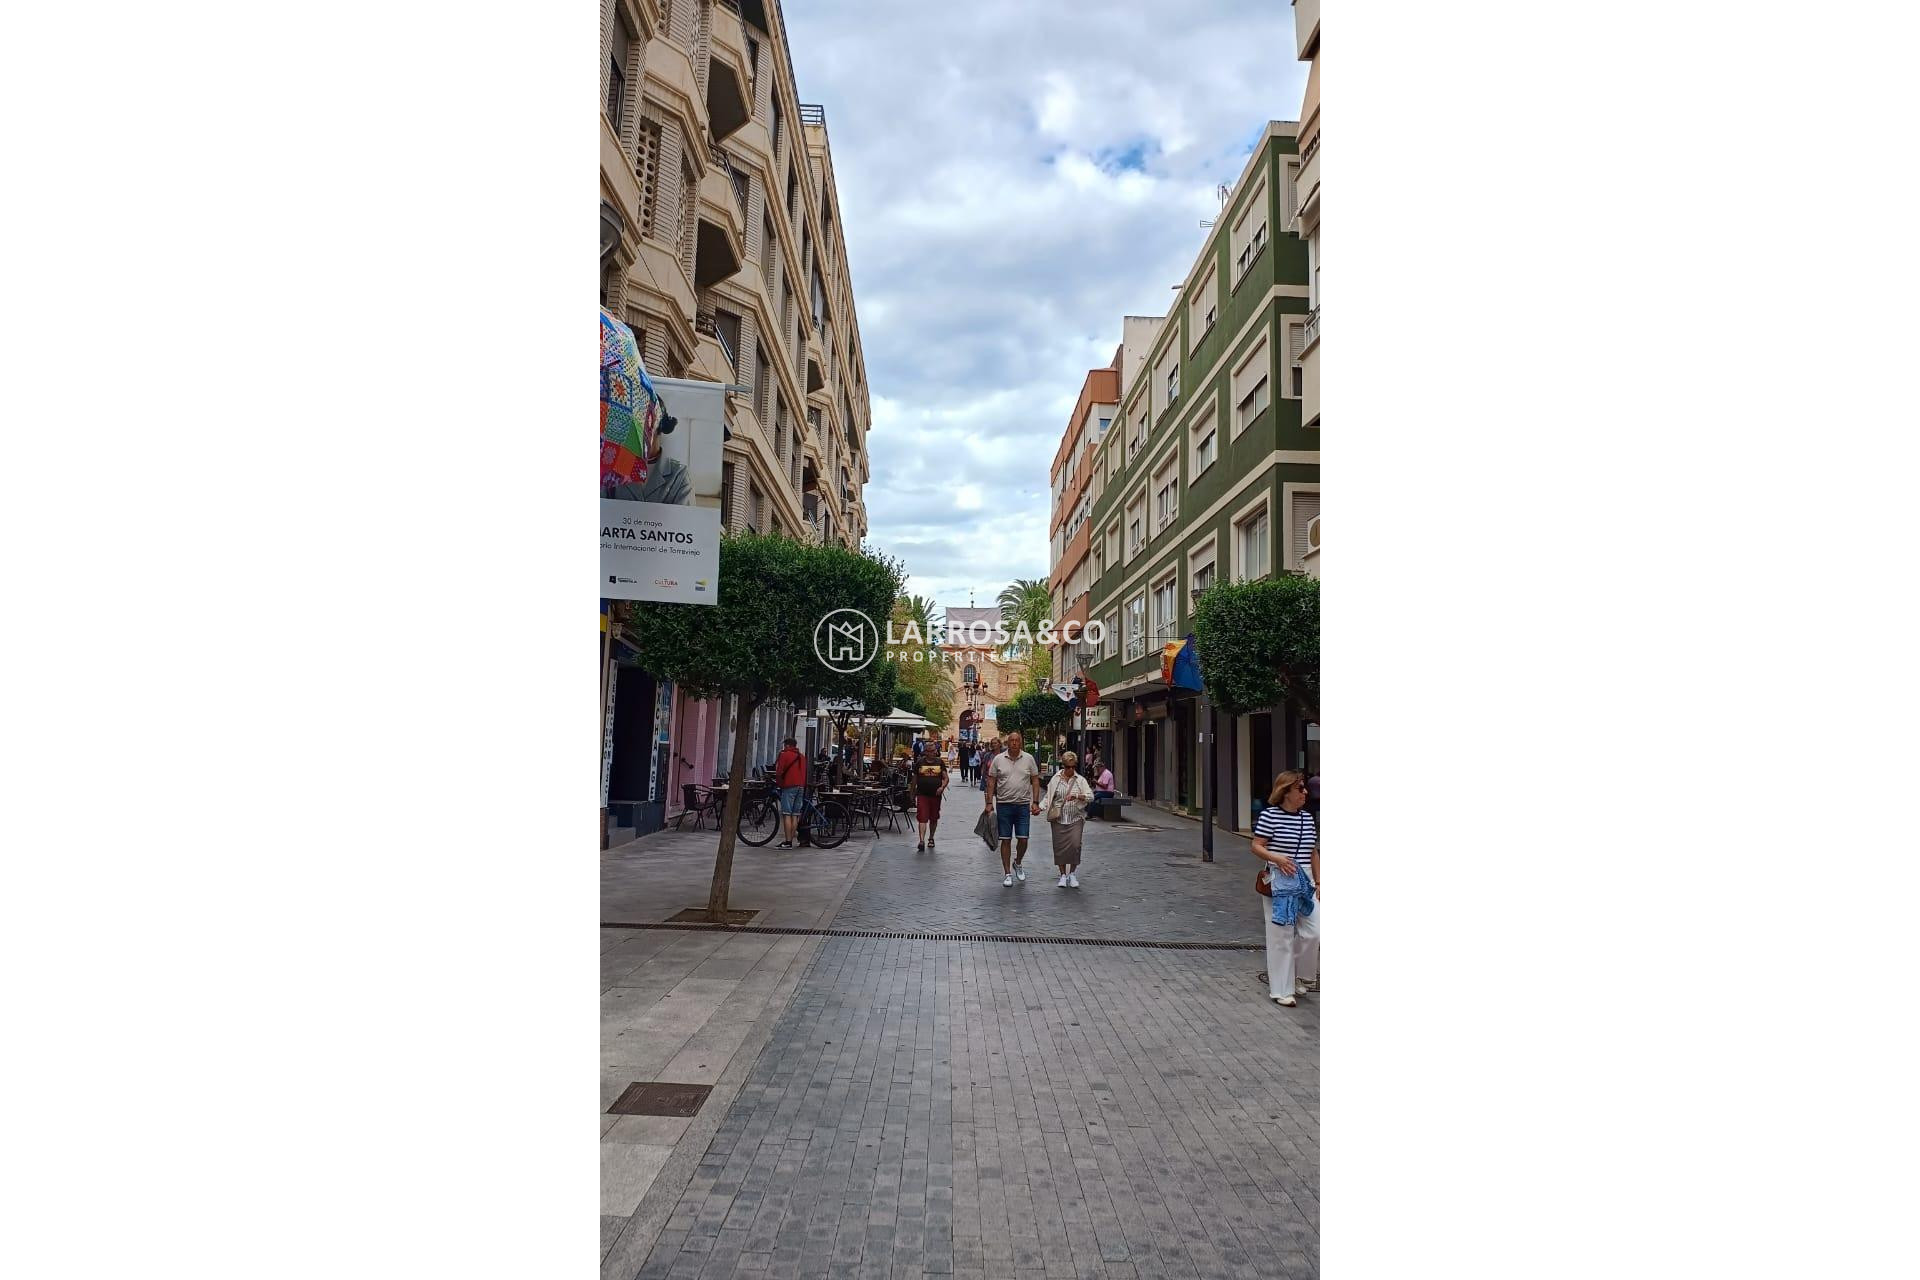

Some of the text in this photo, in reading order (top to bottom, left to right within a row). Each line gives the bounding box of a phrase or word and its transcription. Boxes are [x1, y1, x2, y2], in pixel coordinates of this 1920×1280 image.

[622, 517, 663, 528] 30 de mayo
[600, 527, 693, 544] ARTA SANTOS
[613, 542, 657, 553] Internacional
